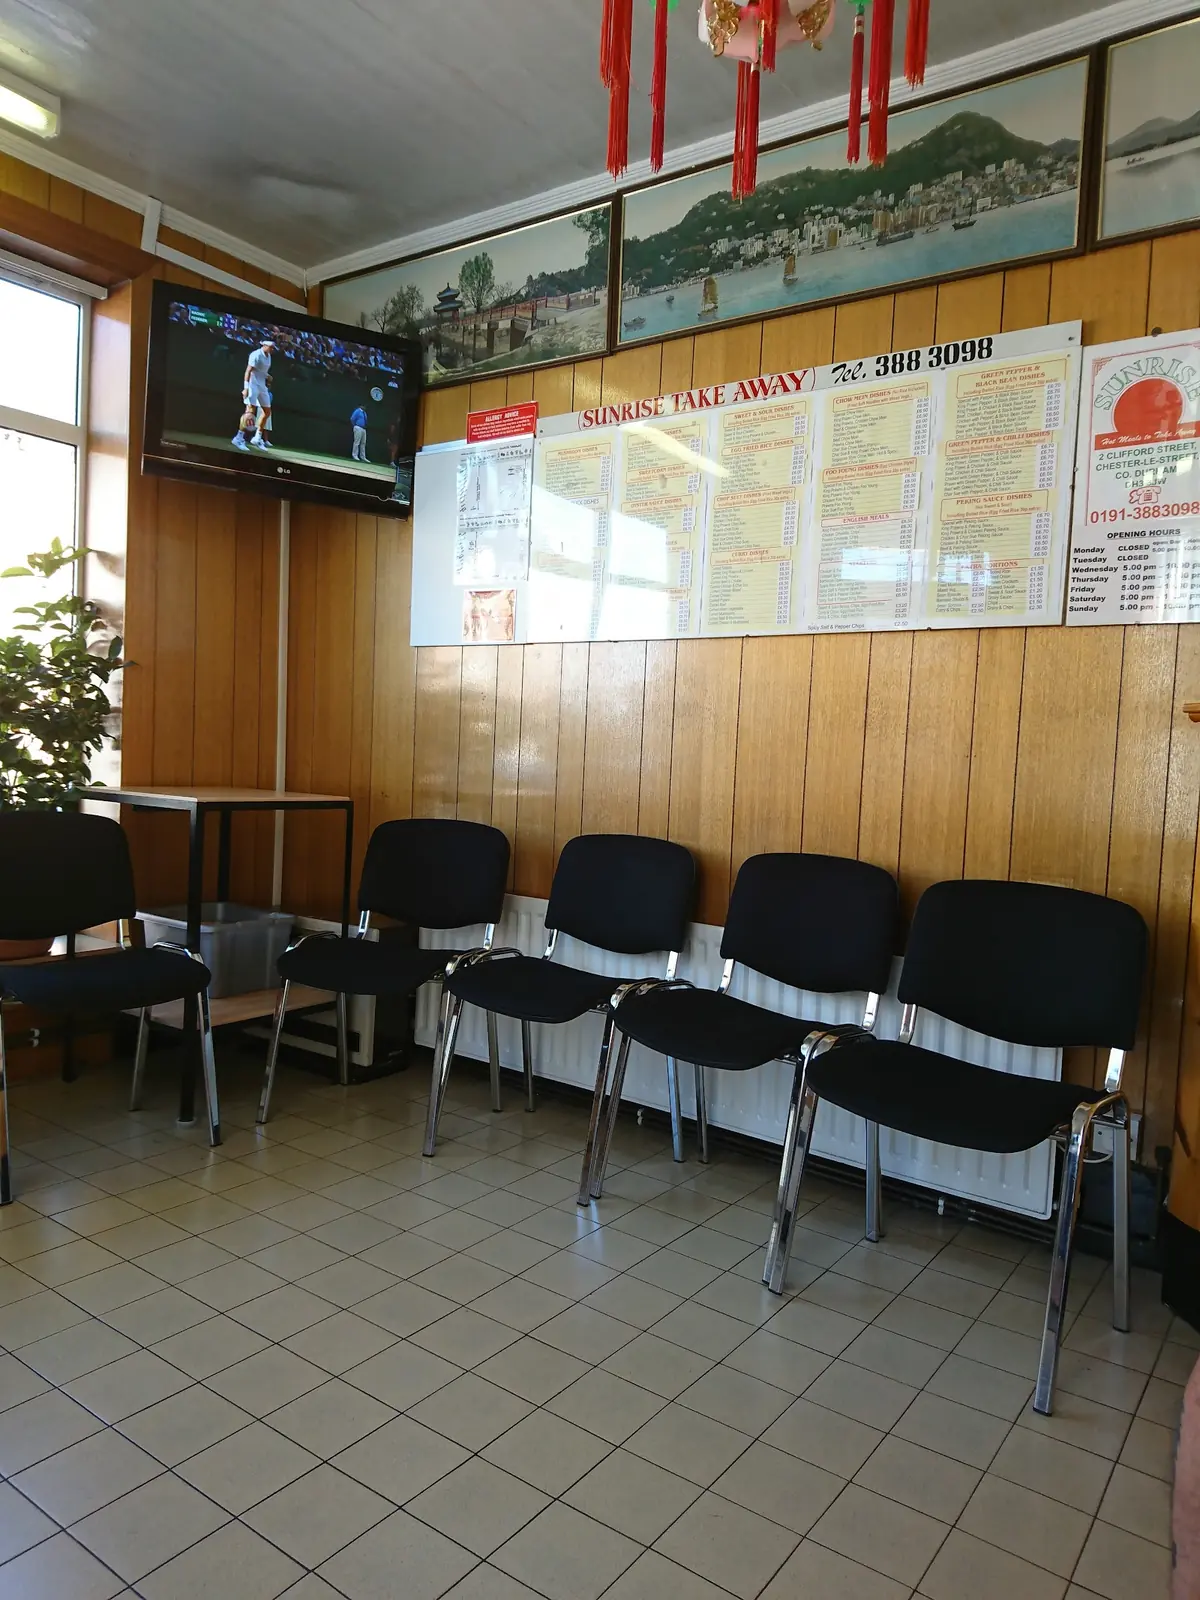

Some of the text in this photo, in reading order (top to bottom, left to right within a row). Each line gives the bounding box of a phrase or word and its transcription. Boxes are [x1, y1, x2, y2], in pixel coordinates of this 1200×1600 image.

[831, 337, 993, 384] Tel. 388 3098
[981, 371, 1004, 379] GREEN
[1006, 366, 1032, 375] PEPPER
[1020, 372, 1045, 380] DISHES
[1094, 356, 1200, 411] SUNRISE
[583, 369, 808, 428] SUNRISE TAKE AWAY
[972, 437, 995, 445] PEPPER
[1106, 448, 1154, 460] CLIFFORD
[1157, 442, 1197, 454] STREET,
[1116, 472, 1132, 480] CO.
[1090, 502, 1200, 523] 0191-3883098
[1107, 528, 1180, 538] OPENING HOURS
[1073, 556, 1107, 564] Tuesday
